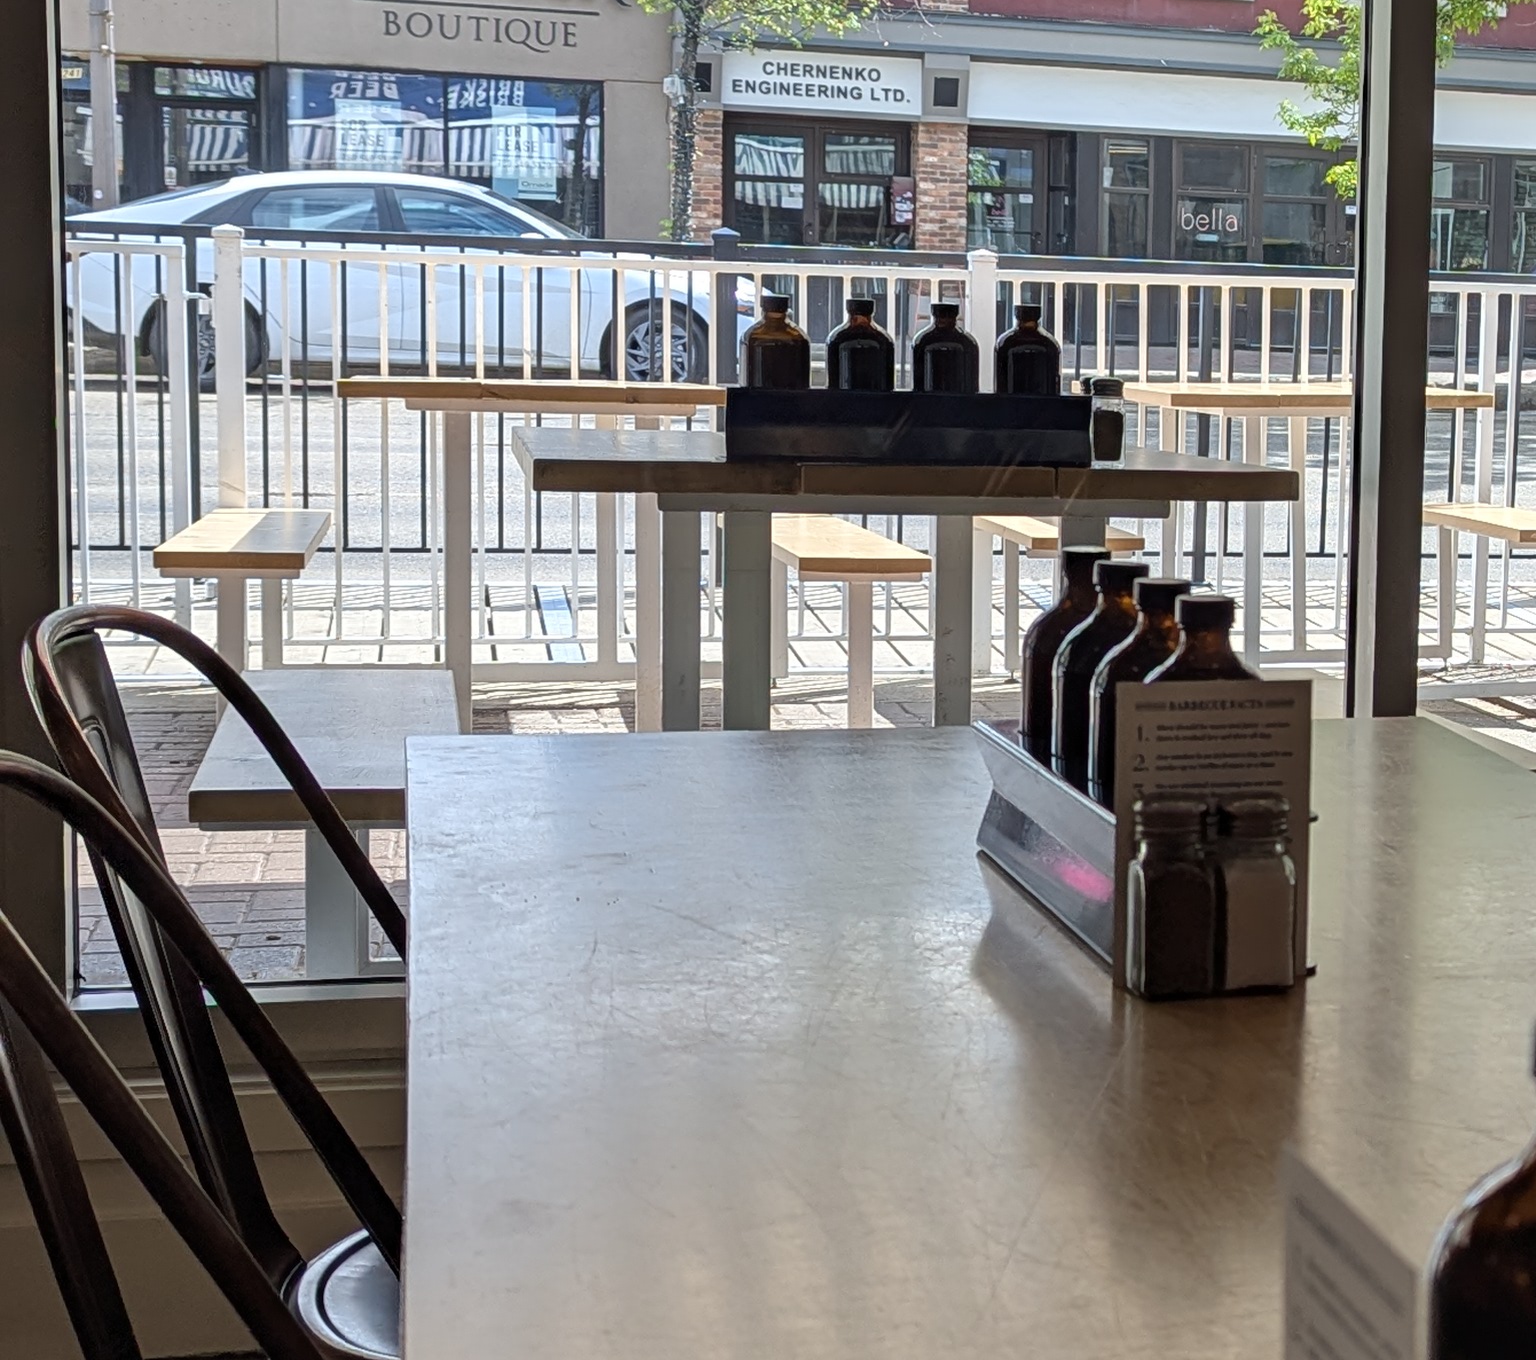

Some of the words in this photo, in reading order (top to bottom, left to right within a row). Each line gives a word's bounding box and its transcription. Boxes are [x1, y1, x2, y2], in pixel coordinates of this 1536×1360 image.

[382, 10, 577, 54] BOUTIQUE
[762, 61, 881, 82] CHERNENKO
[732, 79, 863, 101] ENGINEERING
[870, 87, 911, 103] LTD.
[341, 133, 384, 147] LEASE
[496, 137, 539, 153] LEASE
[1180, 207, 1239, 233] bella
